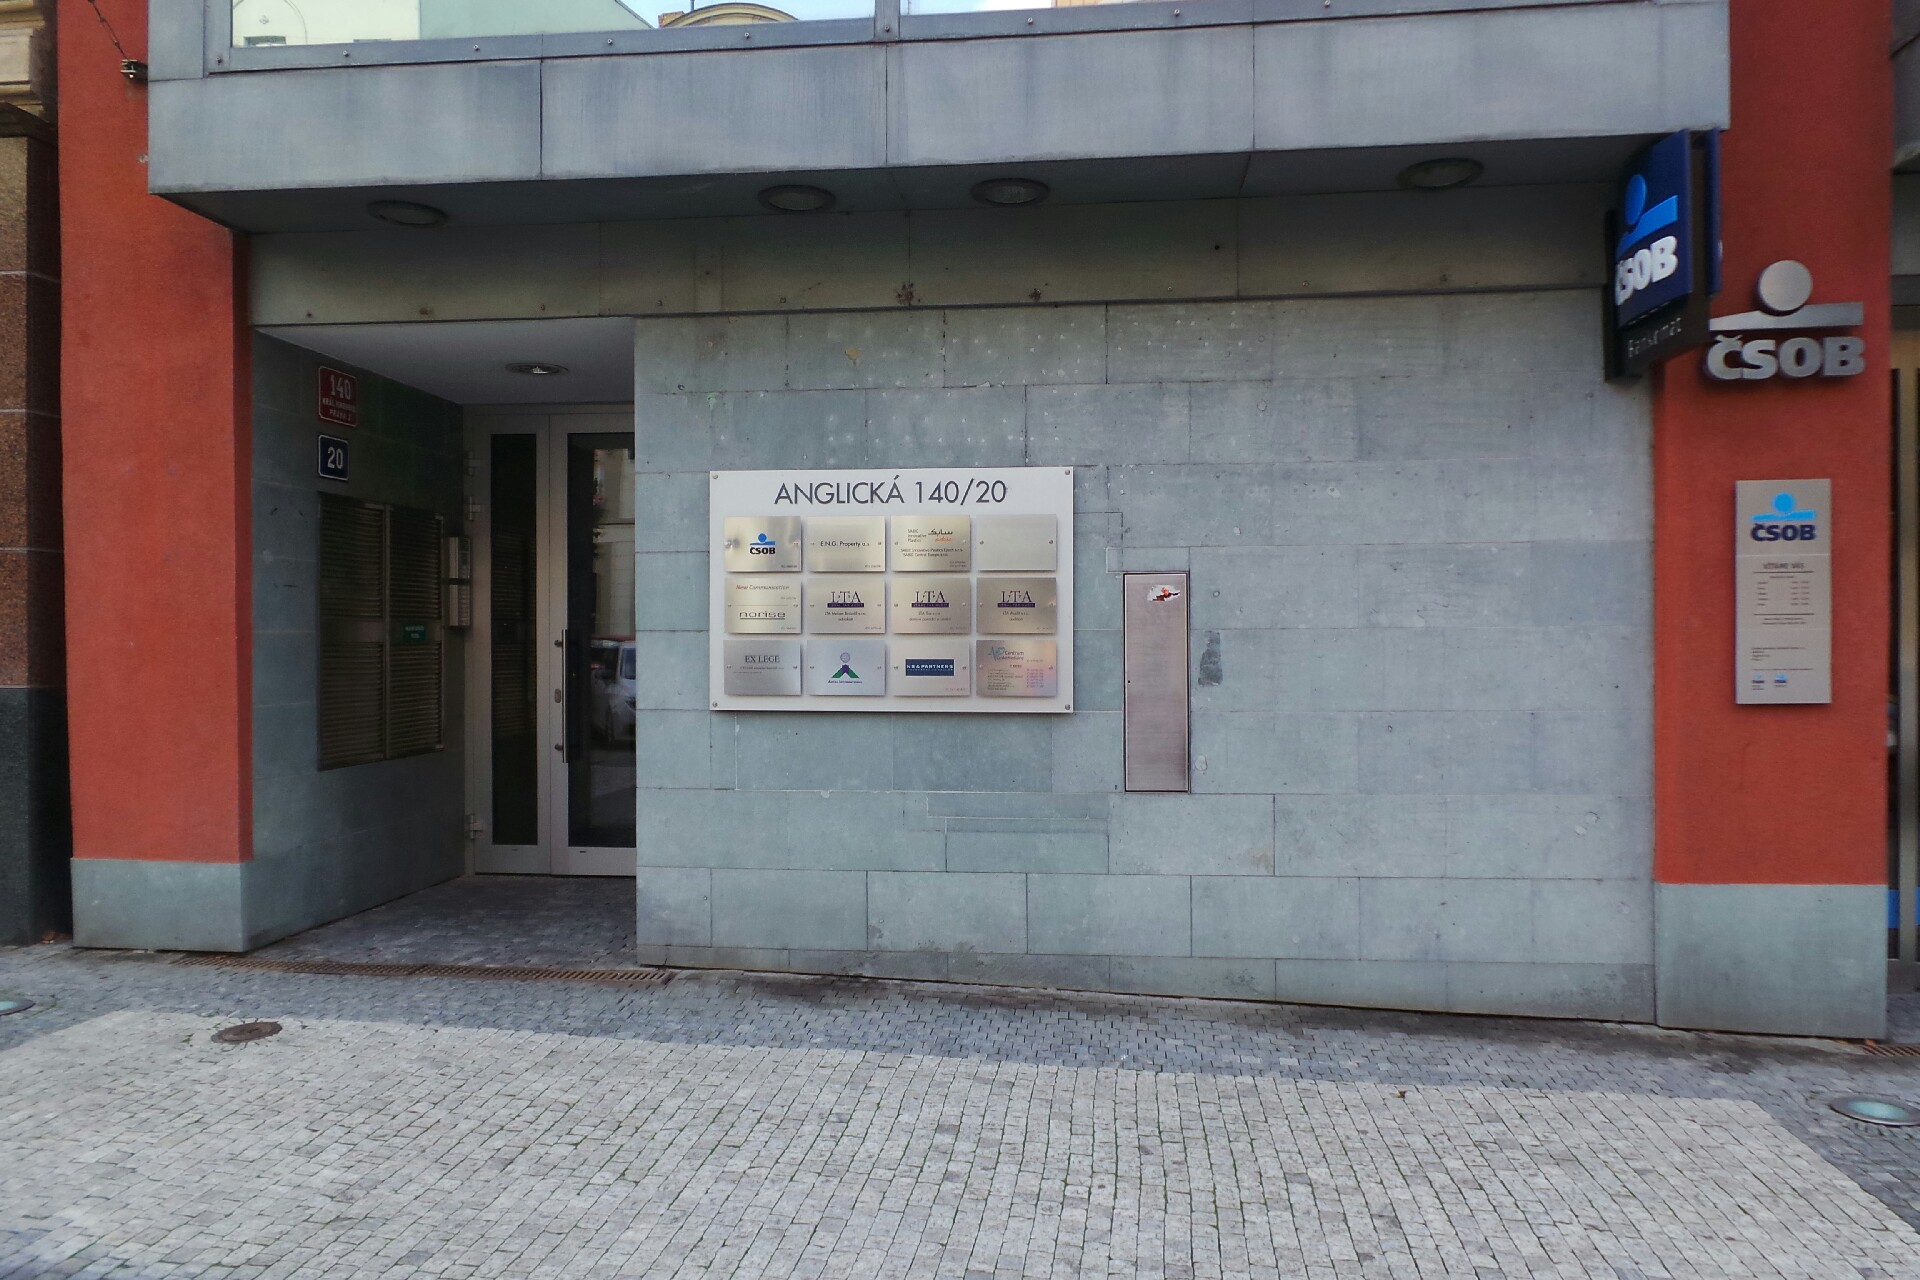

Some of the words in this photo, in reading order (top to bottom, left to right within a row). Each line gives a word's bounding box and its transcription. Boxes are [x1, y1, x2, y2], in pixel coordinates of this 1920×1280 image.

[1706, 334, 1866, 380] ČSOB
[330, 375, 351, 400] 140
[327, 446, 344, 469] 20
[774, 475, 905, 504] ANGLICKÁ
[915, 478, 1008, 505] 140/20
[1751, 523, 1816, 542] ČSOB
[739, 610, 786, 618] norise
[744, 655, 756, 663] EX
[758, 655, 780, 663] LEGE
